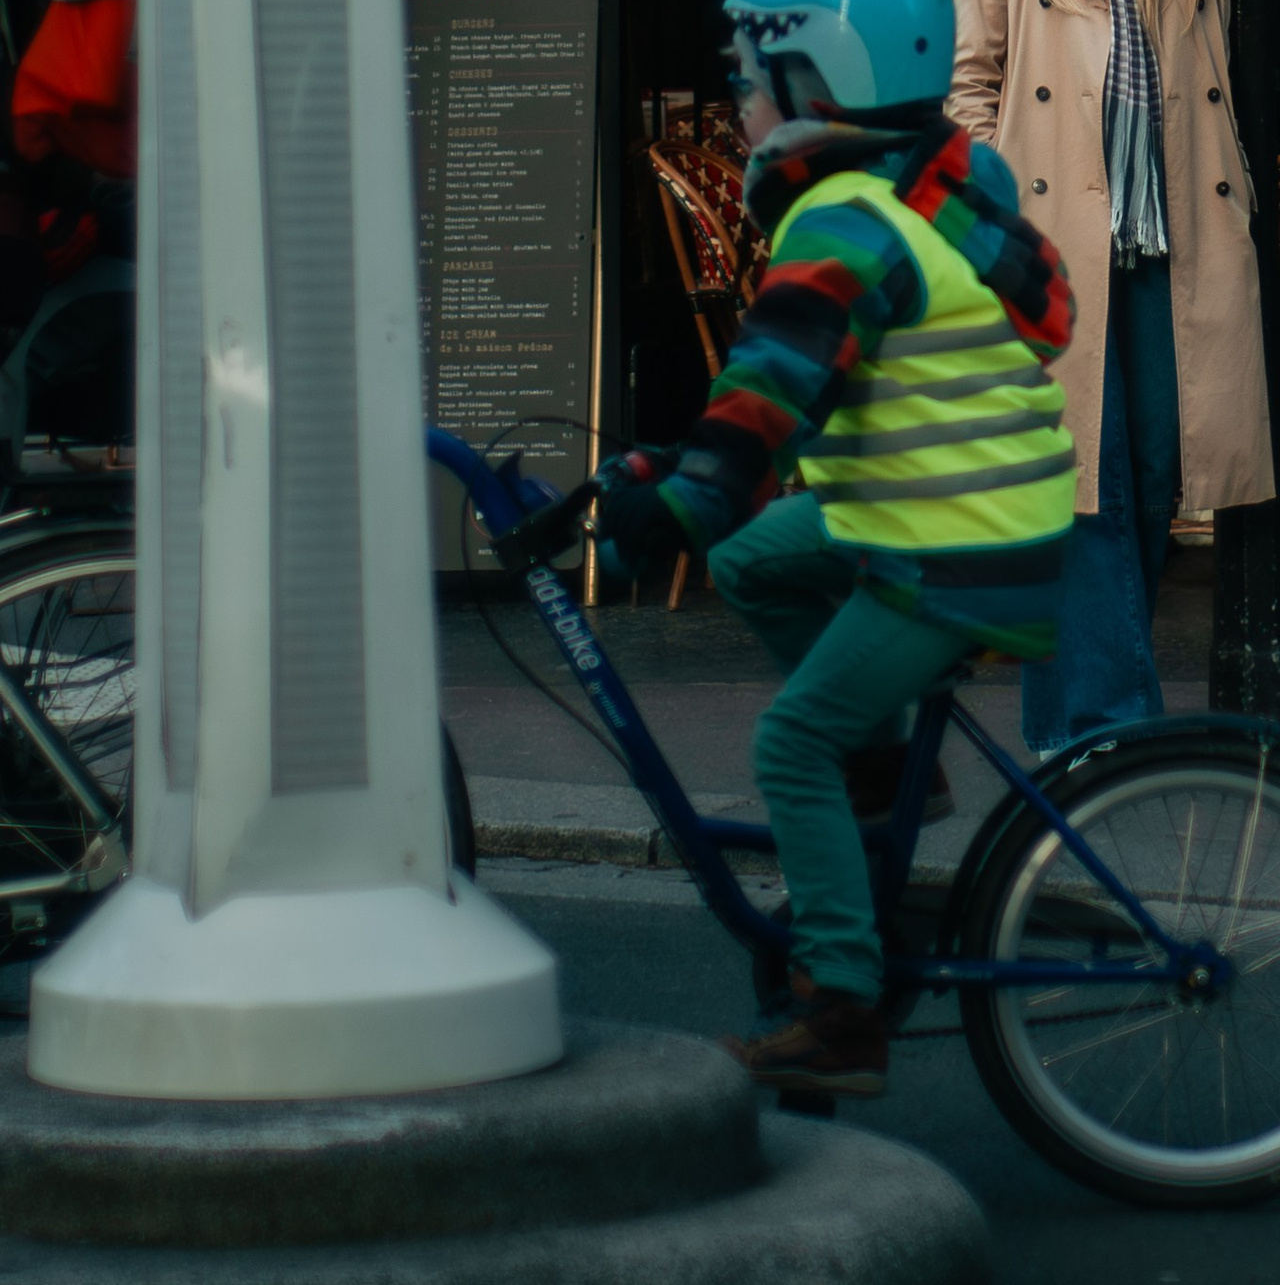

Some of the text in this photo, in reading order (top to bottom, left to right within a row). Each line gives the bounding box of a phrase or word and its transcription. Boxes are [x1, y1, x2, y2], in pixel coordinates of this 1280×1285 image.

[444, 261, 494, 271] PANCAKES
[440, 329, 496, 339] ICE CREAM
